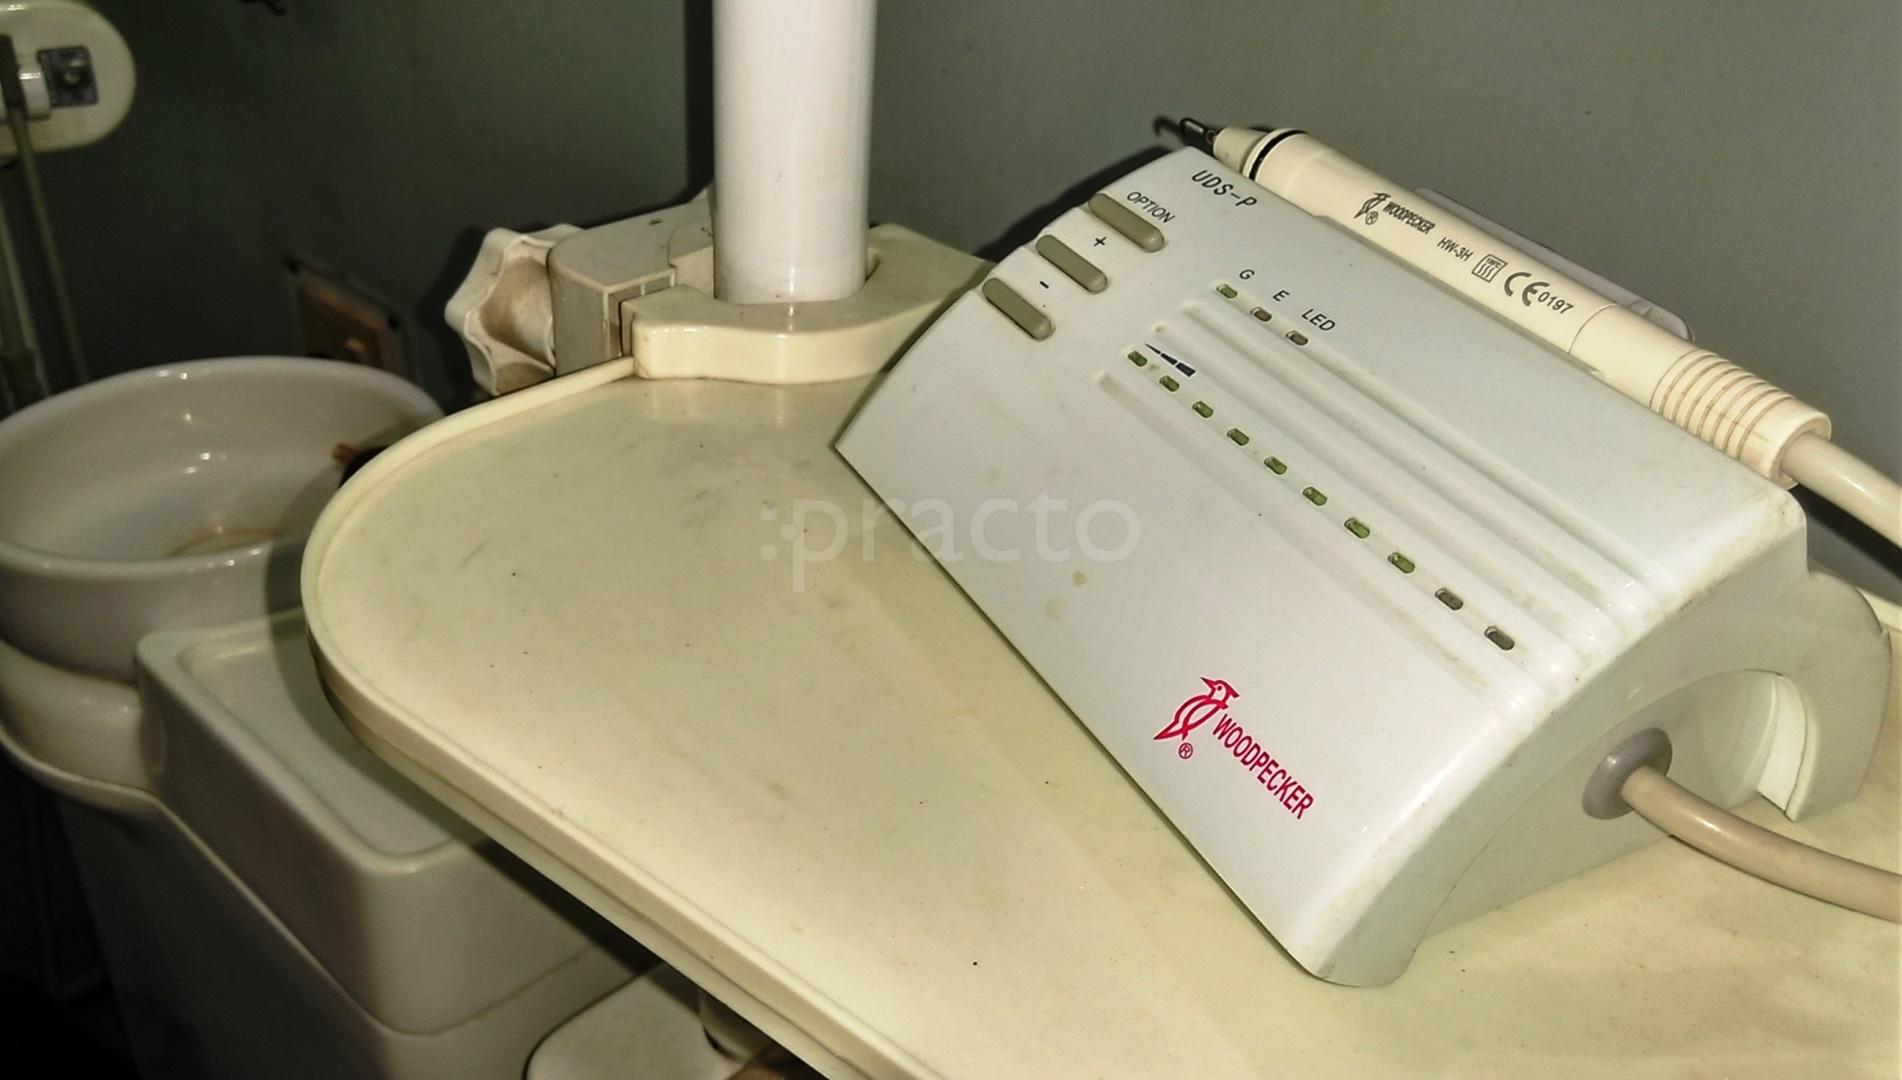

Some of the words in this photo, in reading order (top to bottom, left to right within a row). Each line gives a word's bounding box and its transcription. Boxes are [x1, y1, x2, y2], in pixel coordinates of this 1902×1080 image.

[1191, 169, 1258, 208] UDS-P
[1126, 191, 1176, 224] OPTION
[1239, 268, 1255, 280] G
[1382, 200, 1436, 235] WOODPECKER
[1436, 236, 1474, 262] HW-3H
[1537, 291, 1575, 315] 0197
[1272, 289, 1290, 302] E
[1301, 308, 1336, 332] LED
[1212, 713, 1314, 820] WOODPECKER
